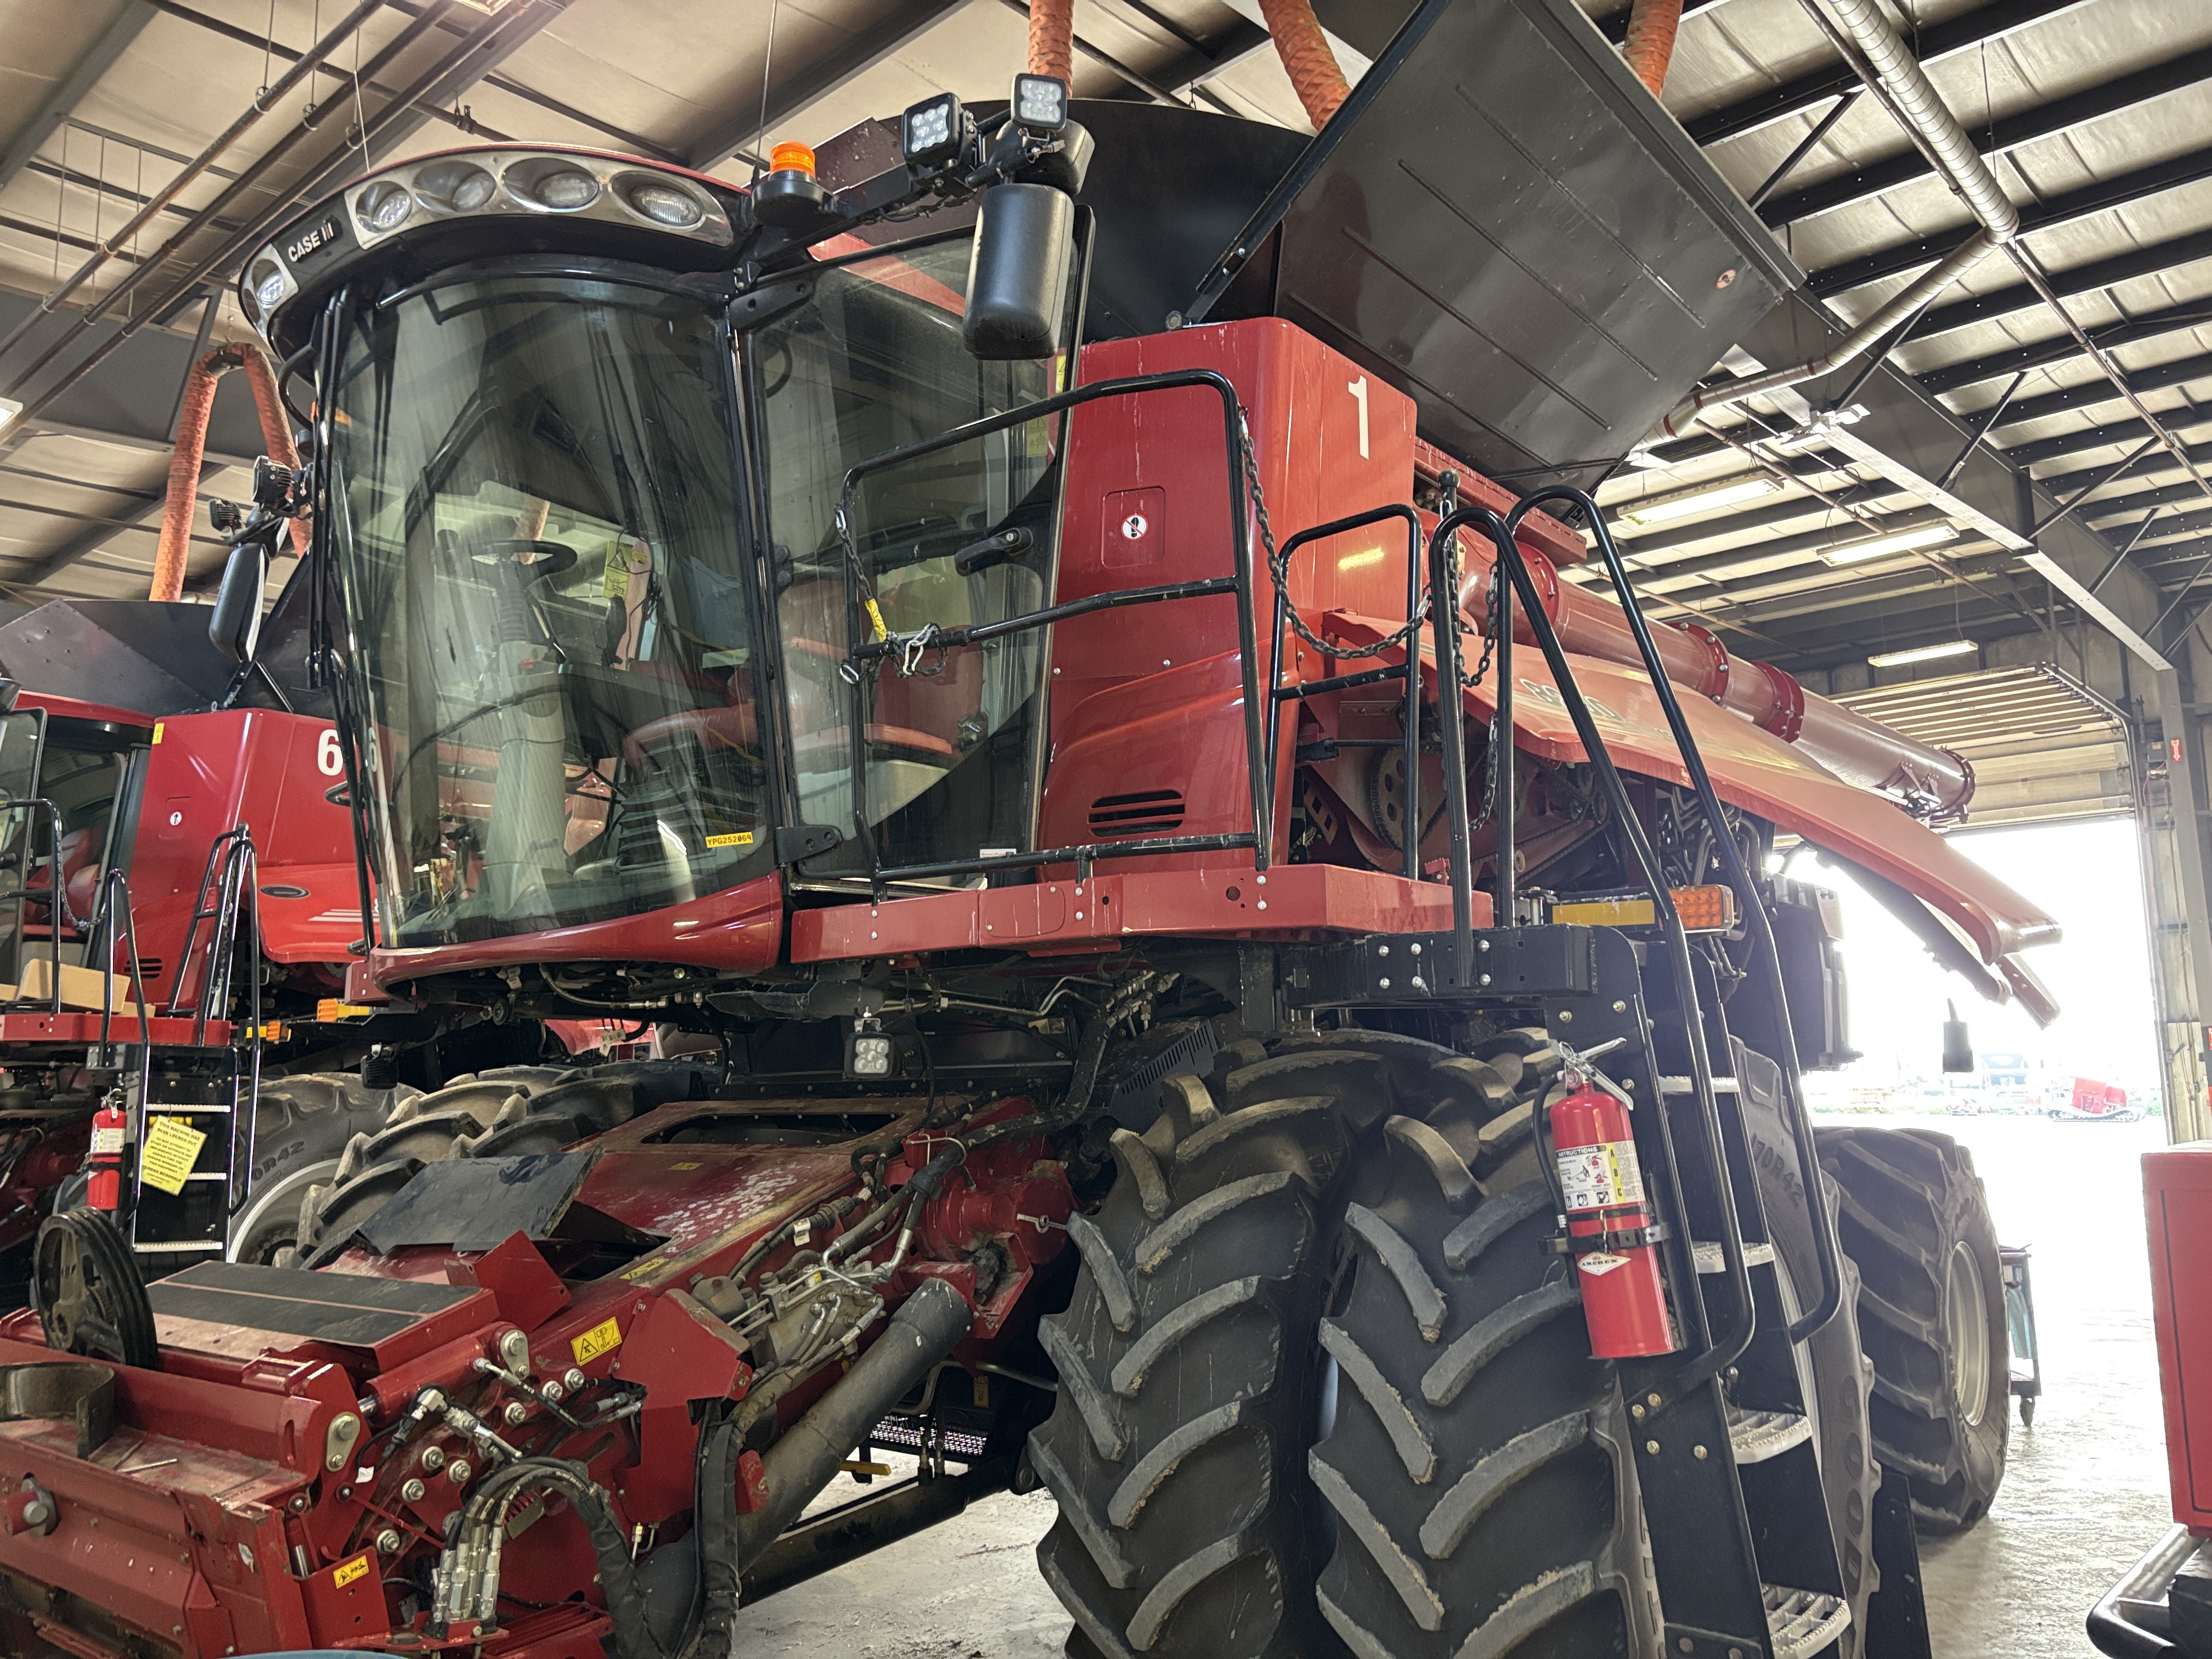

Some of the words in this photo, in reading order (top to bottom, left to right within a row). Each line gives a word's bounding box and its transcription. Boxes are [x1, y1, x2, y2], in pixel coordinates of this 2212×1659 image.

[288, 230, 321, 262] CASE
[1348, 375, 1369, 460] 1
[318, 729, 344, 776] 6
[170, 1126, 190, 1136] MACHINE
[169, 1133, 187, 1142] LOCKED
[1610, 1149, 1615, 1158] A
[1613, 1168, 1618, 1177] B
[1617, 1188, 1622, 1197] C
